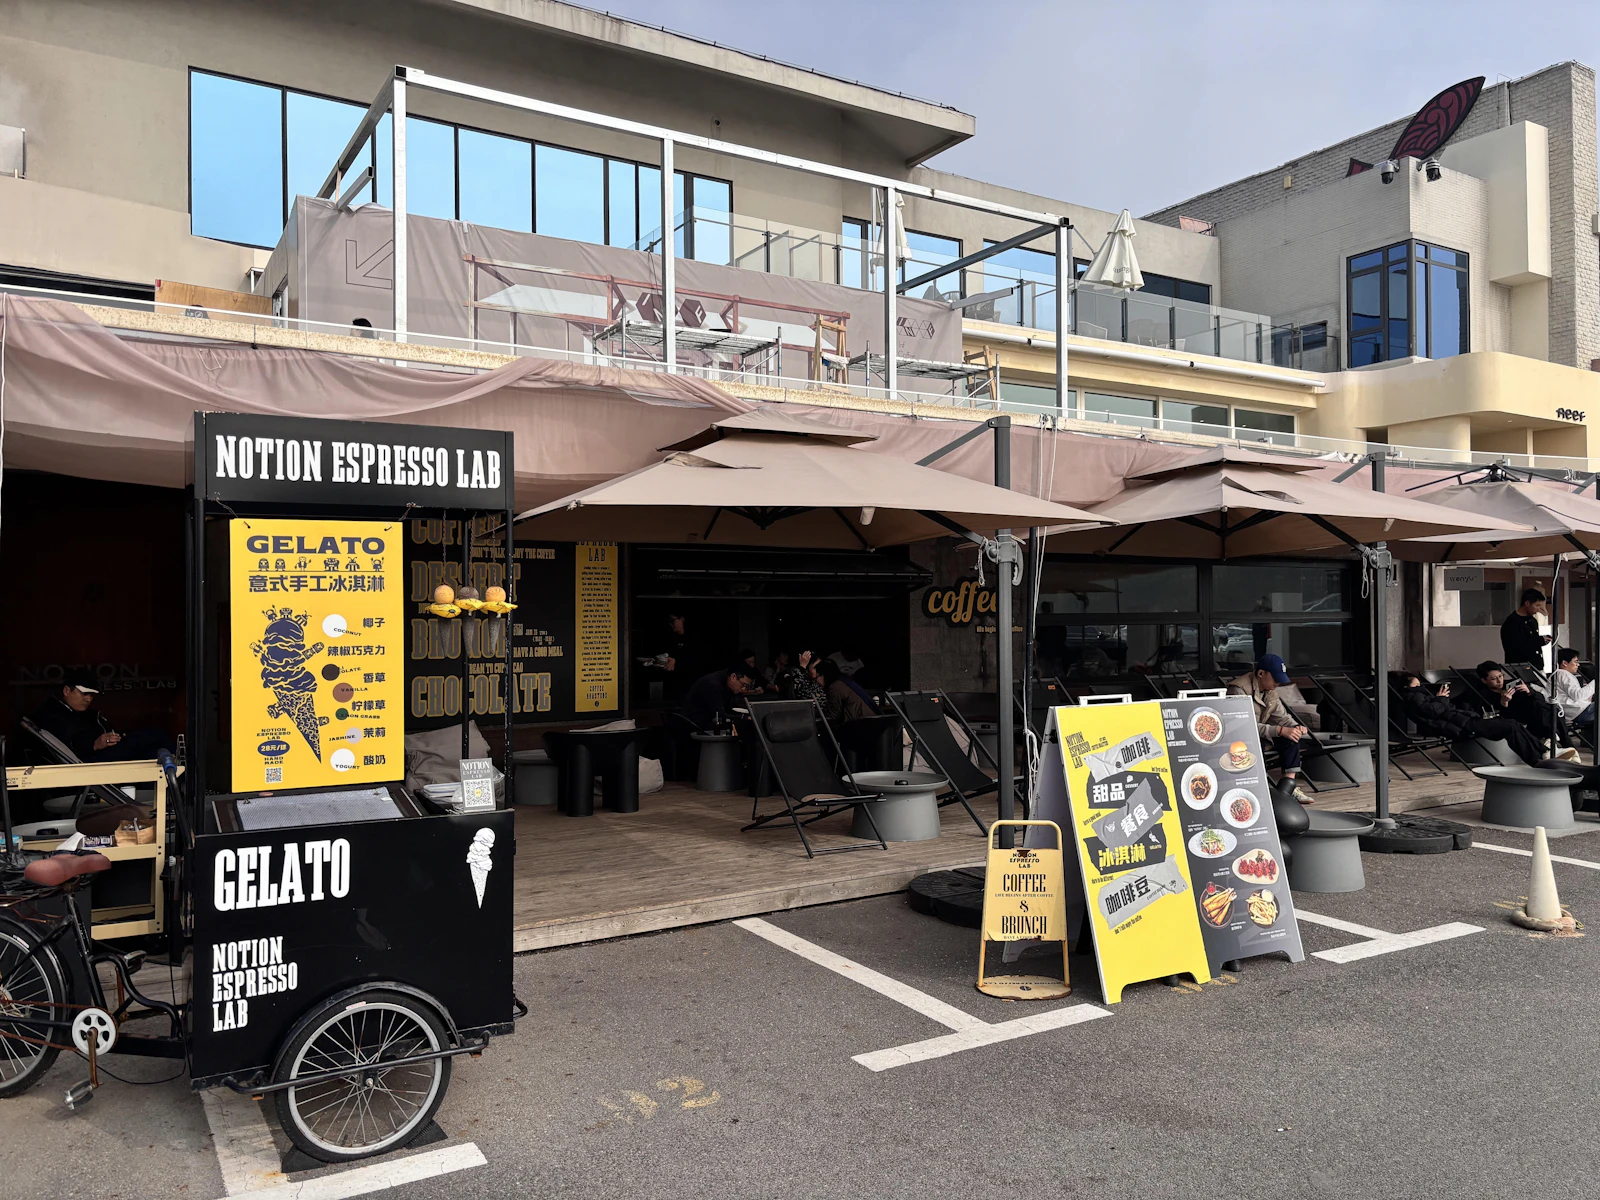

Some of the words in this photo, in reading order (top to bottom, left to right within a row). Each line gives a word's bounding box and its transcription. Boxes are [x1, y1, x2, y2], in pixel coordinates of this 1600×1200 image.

[215, 434, 322, 482] NOTION
[332, 441, 449, 487] ESPRESSO
[456, 449, 501, 489] LAB
[246, 535, 385, 555] GELATO
[525, 548, 536, 559] THE
[537, 549, 556, 559] COFFEE
[248, 575, 385, 593] 意式手工冰淇淋
[333, 627, 362, 637] COCONUT
[362, 617, 386, 628] 椰子
[327, 645, 386, 657] 辣椒巧克力
[513, 647, 528, 658] HAVE
[529, 647, 534, 657] A
[548, 646, 563, 657] MEAL
[363, 672, 386, 683] 香草
[351, 700, 386, 711] 柠檬草
[363, 727, 386, 738] 茉莉
[363, 754, 386, 766] 酸奶
[1121, 737, 1151, 764] 咖啡
[462, 760, 490, 770] NOTION
[1092, 782, 1125, 803] 甜品
[1121, 803, 1150, 838] 餐食
[1098, 843, 1147, 868] 冰淇淋
[213, 838, 350, 912] GELATO
[1003, 873, 1046, 893] COFFEE
[1105, 875, 1151, 915] 咖啡豆
[1002, 916, 1047, 934] BRUNCH
[212, 936, 283, 972] NOTION
[212, 962, 298, 1002] ESPRESSO
[212, 999, 248, 1032] LAB
